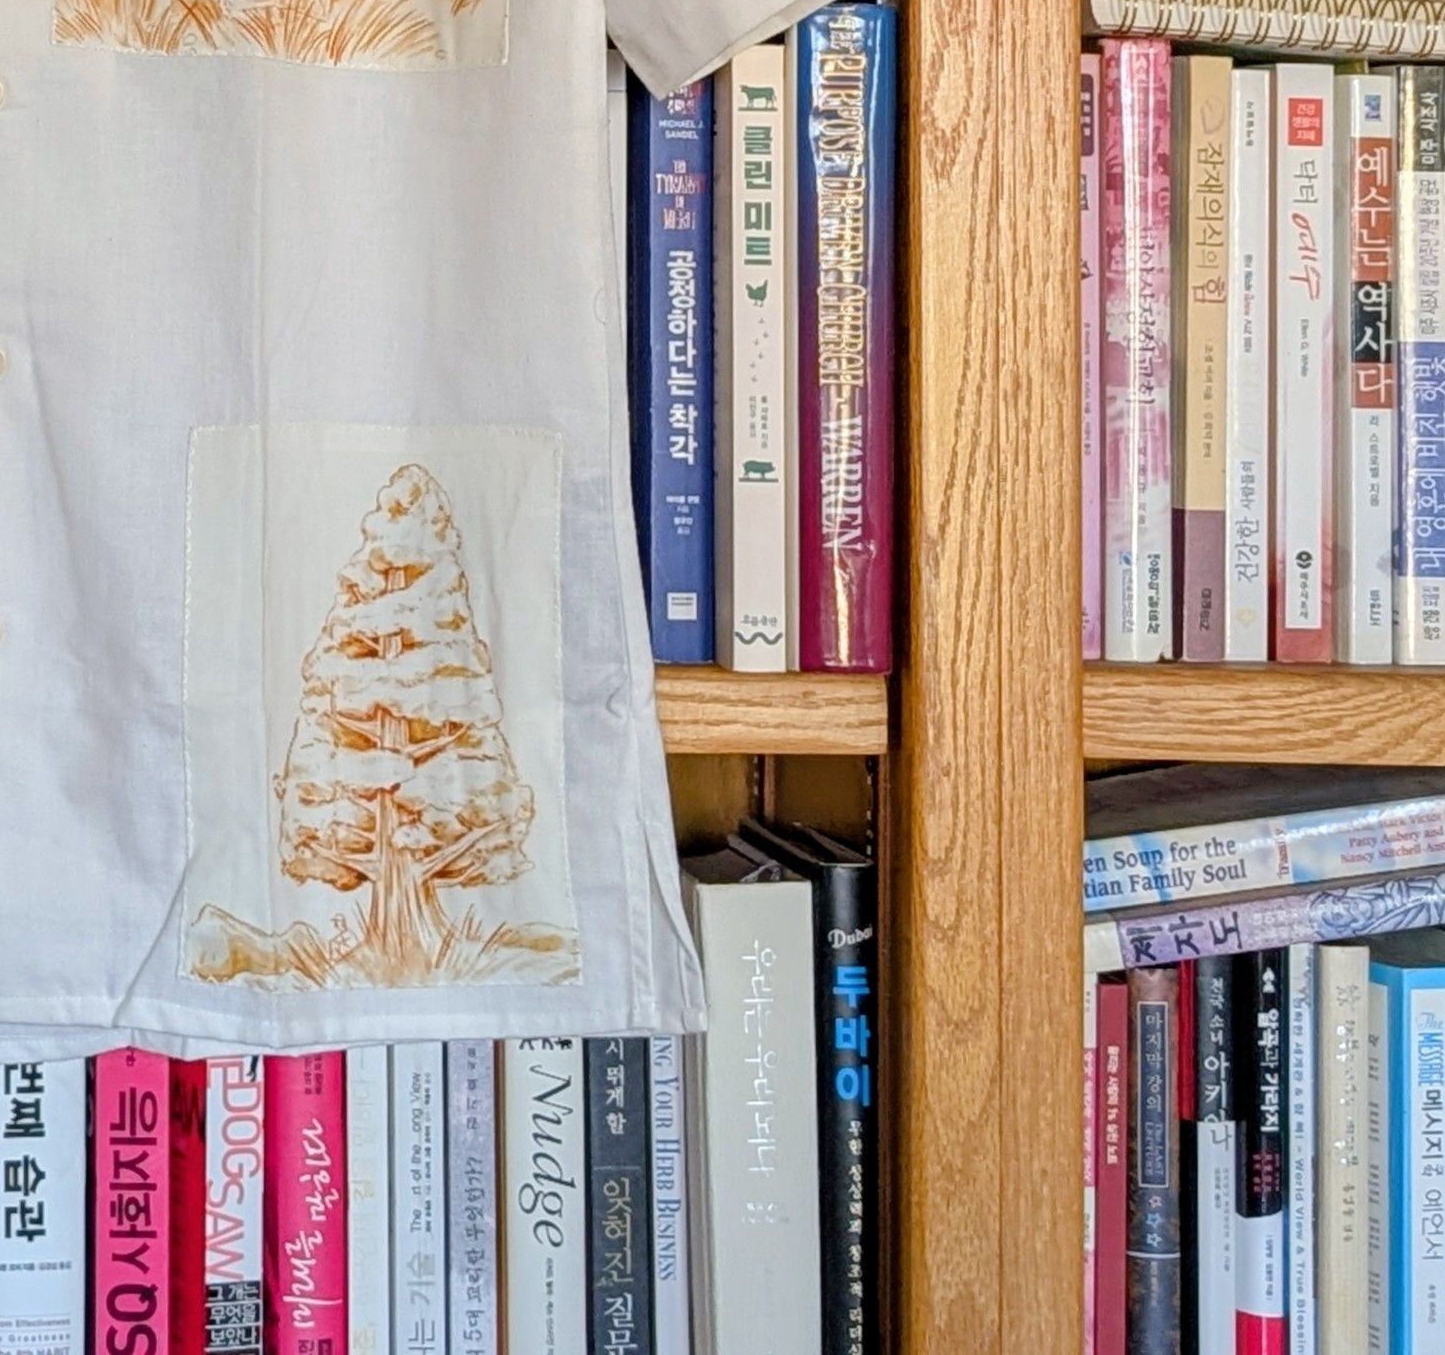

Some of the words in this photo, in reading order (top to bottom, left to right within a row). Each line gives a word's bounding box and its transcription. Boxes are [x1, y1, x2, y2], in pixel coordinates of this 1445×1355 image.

[658, 119, 695, 130] MICHAEL
[1420, 91, 1438, 132] 시조사
[665, 129, 699, 140] SANDEL
[1419, 138, 1438, 165] 미주
[743, 125, 773, 191] 클린
[1293, 160, 1318, 204] 닥터
[1192, 140, 1224, 270] 잠재의식의
[1355, 148, 1392, 266] 예수는
[743, 201, 773, 266] 미트
[1190, 273, 1226, 305] 힘
[667, 251, 696, 396] 공정하다는
[1355, 281, 1395, 406] 역사다
[669, 404, 697, 466] 착각
[819, 415, 864, 552] WARREN
[1240, 460, 1255, 511] 사람들의
[1236, 517, 1260, 583] 건강한
[1113, 848, 1164, 875] Soup
[1170, 843, 1198, 864] for
[1203, 837, 1237, 858] the
[1128, 864, 1196, 895] Family
[1203, 860, 1248, 884] Soul
[828, 926, 873, 949] Dubai
[832, 965, 872, 1109] 두바이
[1144, 1011, 1163, 1070] 마지막
[1418, 1031, 1444, 1087] MESSAGE
[410, 1072, 422, 1103] View
[655, 1075, 680, 1129] YOUR
[1144, 1074, 1163, 1113] 강의
[221, 1082, 262, 1178] DOG
[410, 1108, 424, 1141] ong
[409, 1145, 422, 1164] the
[409, 1168, 422, 1181] of
[518, 1064, 577, 1248] Nudge
[656, 1137, 681, 1190] HERB
[1295, 1158, 1307, 1201] World
[206, 1181, 244, 1282] SAW
[410, 1209, 423, 1233] The
[658, 1197, 682, 1281] BUSINESS
[1295, 1207, 1307, 1239] View
[228, 1284, 259, 1299] 개는
[1295, 1261, 1307, 1293] True
[210, 1305, 257, 1325] 무엇을
[209, 1328, 257, 1347] 보았나
